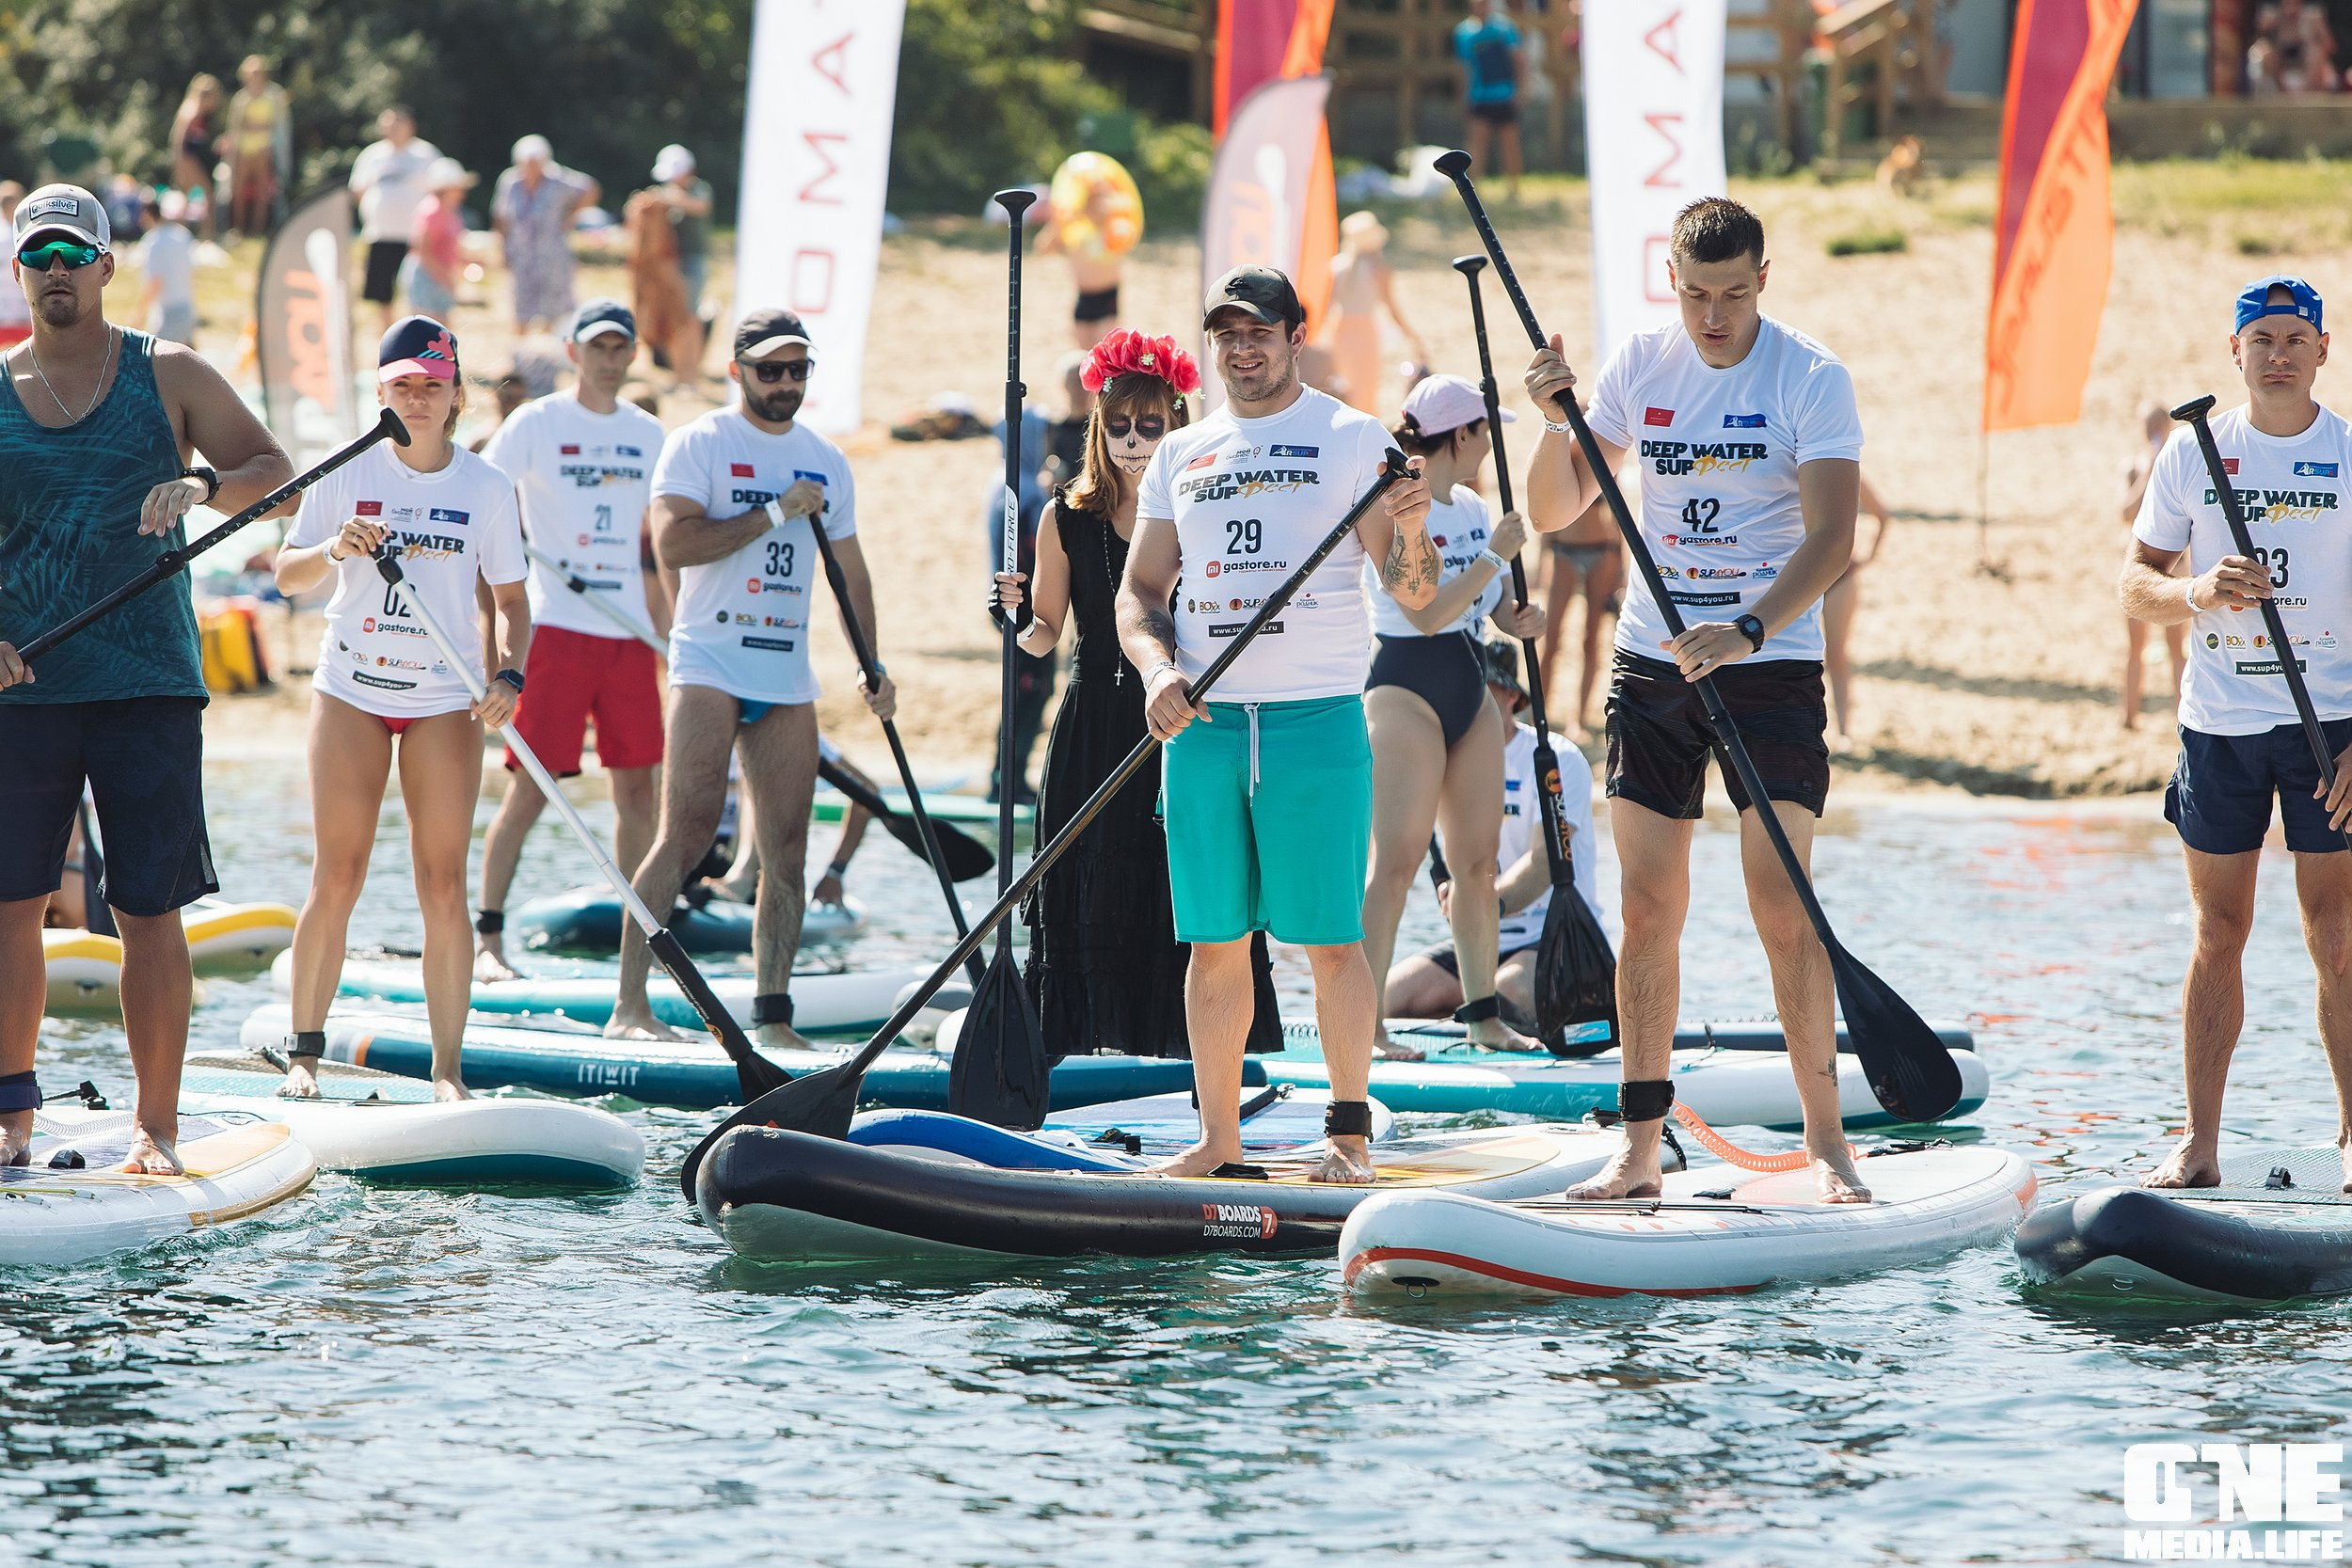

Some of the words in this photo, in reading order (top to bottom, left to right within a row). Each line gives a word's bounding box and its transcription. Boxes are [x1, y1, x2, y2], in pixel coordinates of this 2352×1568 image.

[31, 199, 75, 214] Quiksilver
[1641, 439, 1688, 459] DEEP
[1691, 443, 1768, 459] WATER
[1656, 459, 1694, 476] SUP
[1178, 473, 1232, 497] DEEP
[1234, 469, 1320, 485] WATER
[732, 489, 773, 504] DEEP
[1194, 486, 1239, 503] SUP
[2203, 489, 2260, 505] DEP
[2263, 490, 2338, 510] WATER
[596, 504, 612, 531] 21
[1681, 498, 1721, 533] 42
[401, 531, 465, 554] WATER
[1007, 499, 1015, 576] RO-FORCE
[1226, 519, 1263, 555] 29
[1679, 535, 1738, 546] gastore.ru
[765, 541, 794, 578] 33
[1223, 560, 1287, 574] gastore.ru
[1213, 625, 1278, 635] www.suu.ru
[578, 1063, 640, 1086] ITIWIT
[1201, 1203, 1262, 1223] D7BOARDS
[1203, 1225, 1262, 1239] D7BOARDS.COM
